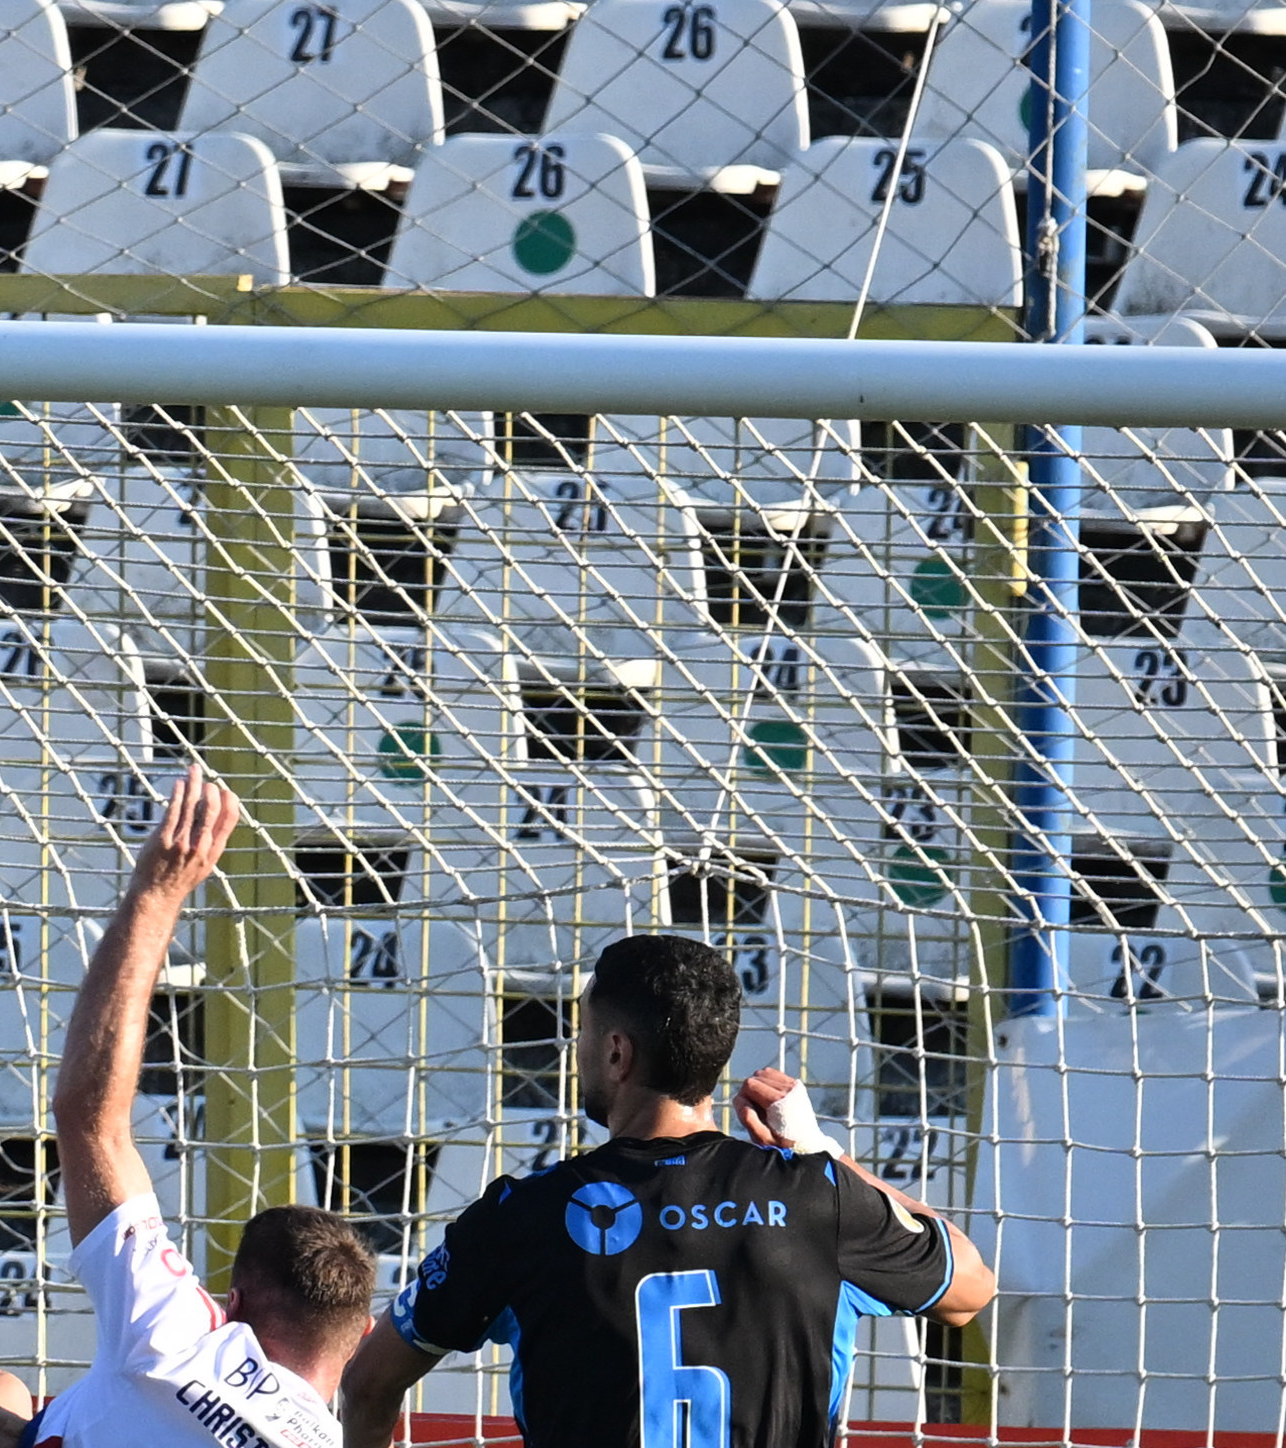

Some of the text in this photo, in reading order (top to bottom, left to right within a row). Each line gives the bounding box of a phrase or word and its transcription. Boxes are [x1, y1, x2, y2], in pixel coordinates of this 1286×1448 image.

[291, 8, 338, 62] 27
[663, 8, 715, 59] 26
[146, 142, 191, 197] 27
[512, 146, 565, 197] 26
[873, 150, 927, 203] 25
[1133, 650, 1188, 707] 23
[350, 931, 402, 988] 24
[1110, 943, 1168, 999] 22
[882, 1115, 938, 1179] 22
[659, 1200, 788, 1231] OSCAR
